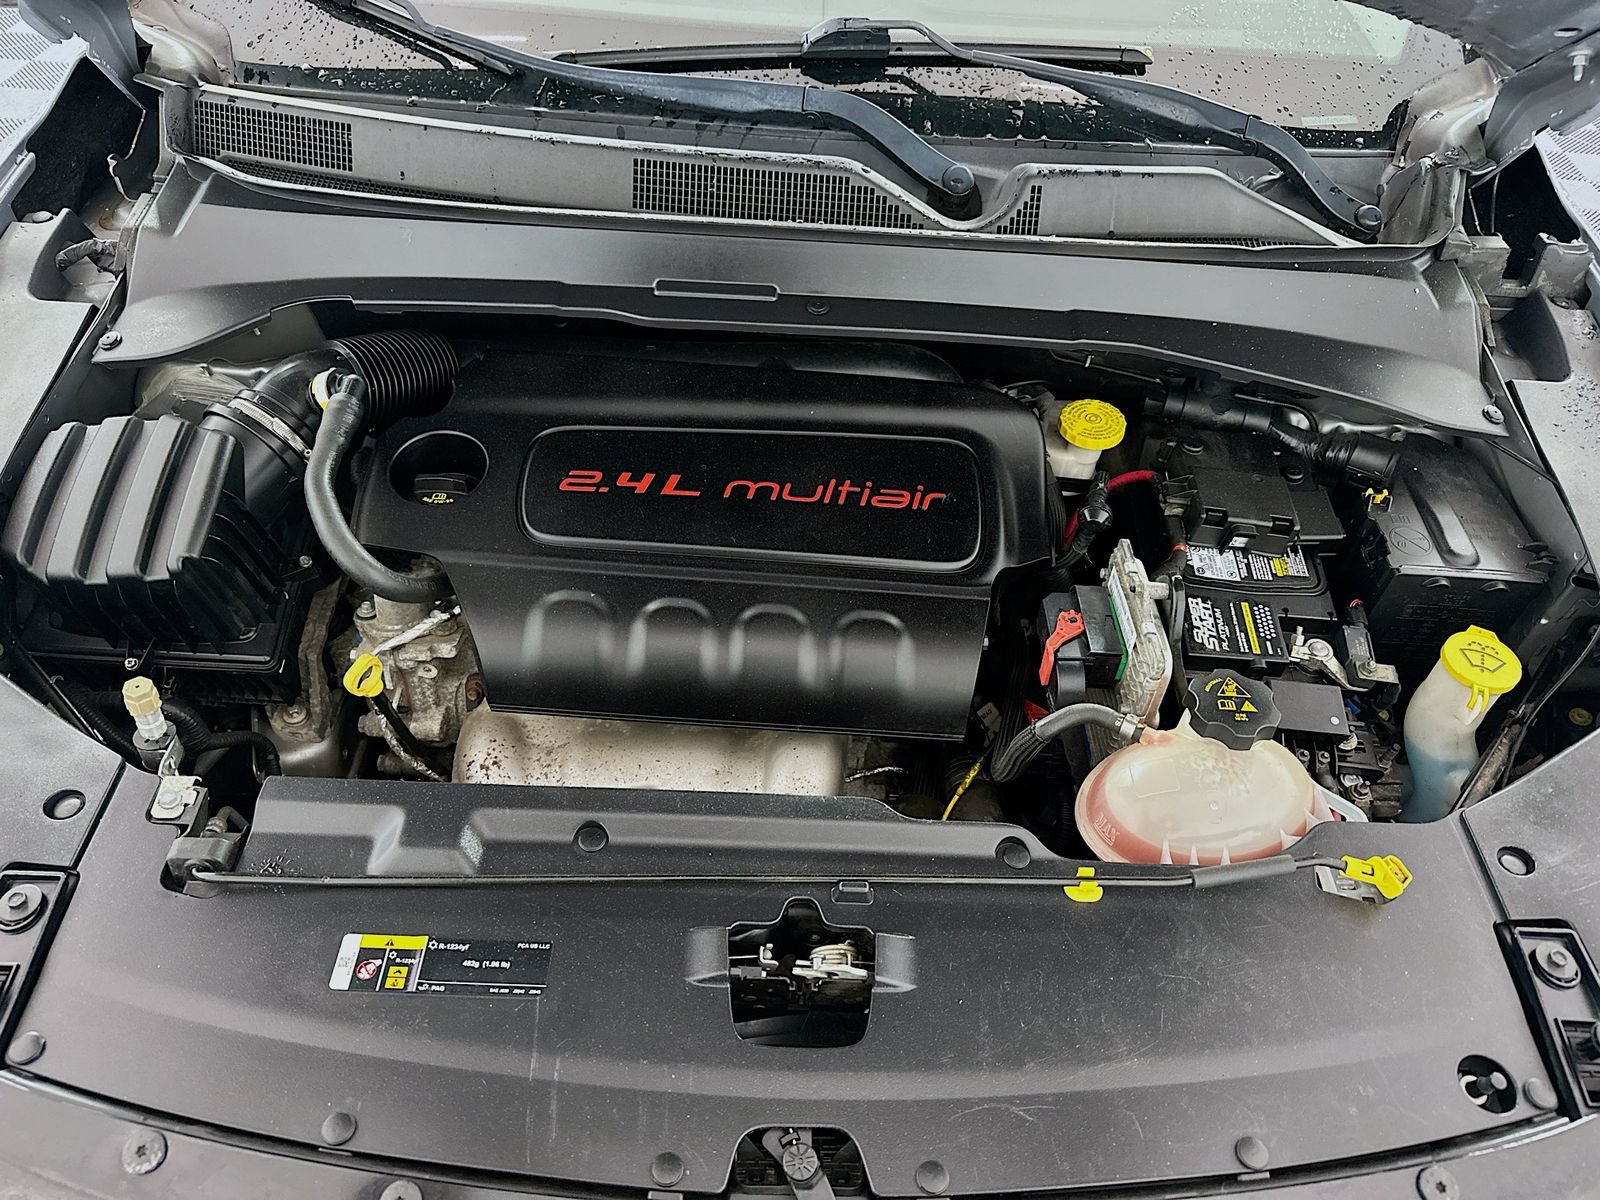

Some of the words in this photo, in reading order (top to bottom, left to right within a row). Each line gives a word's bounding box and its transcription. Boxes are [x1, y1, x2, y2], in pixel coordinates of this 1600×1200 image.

[723, 478, 946, 511] multiair
[1187, 597, 1202, 644] SUPER
[1200, 600, 1220, 652] START
[1213, 607, 1230, 651] PLATINUM
[1095, 811, 1120, 843] MAX
[438, 942, 471, 952] R-1234yf
